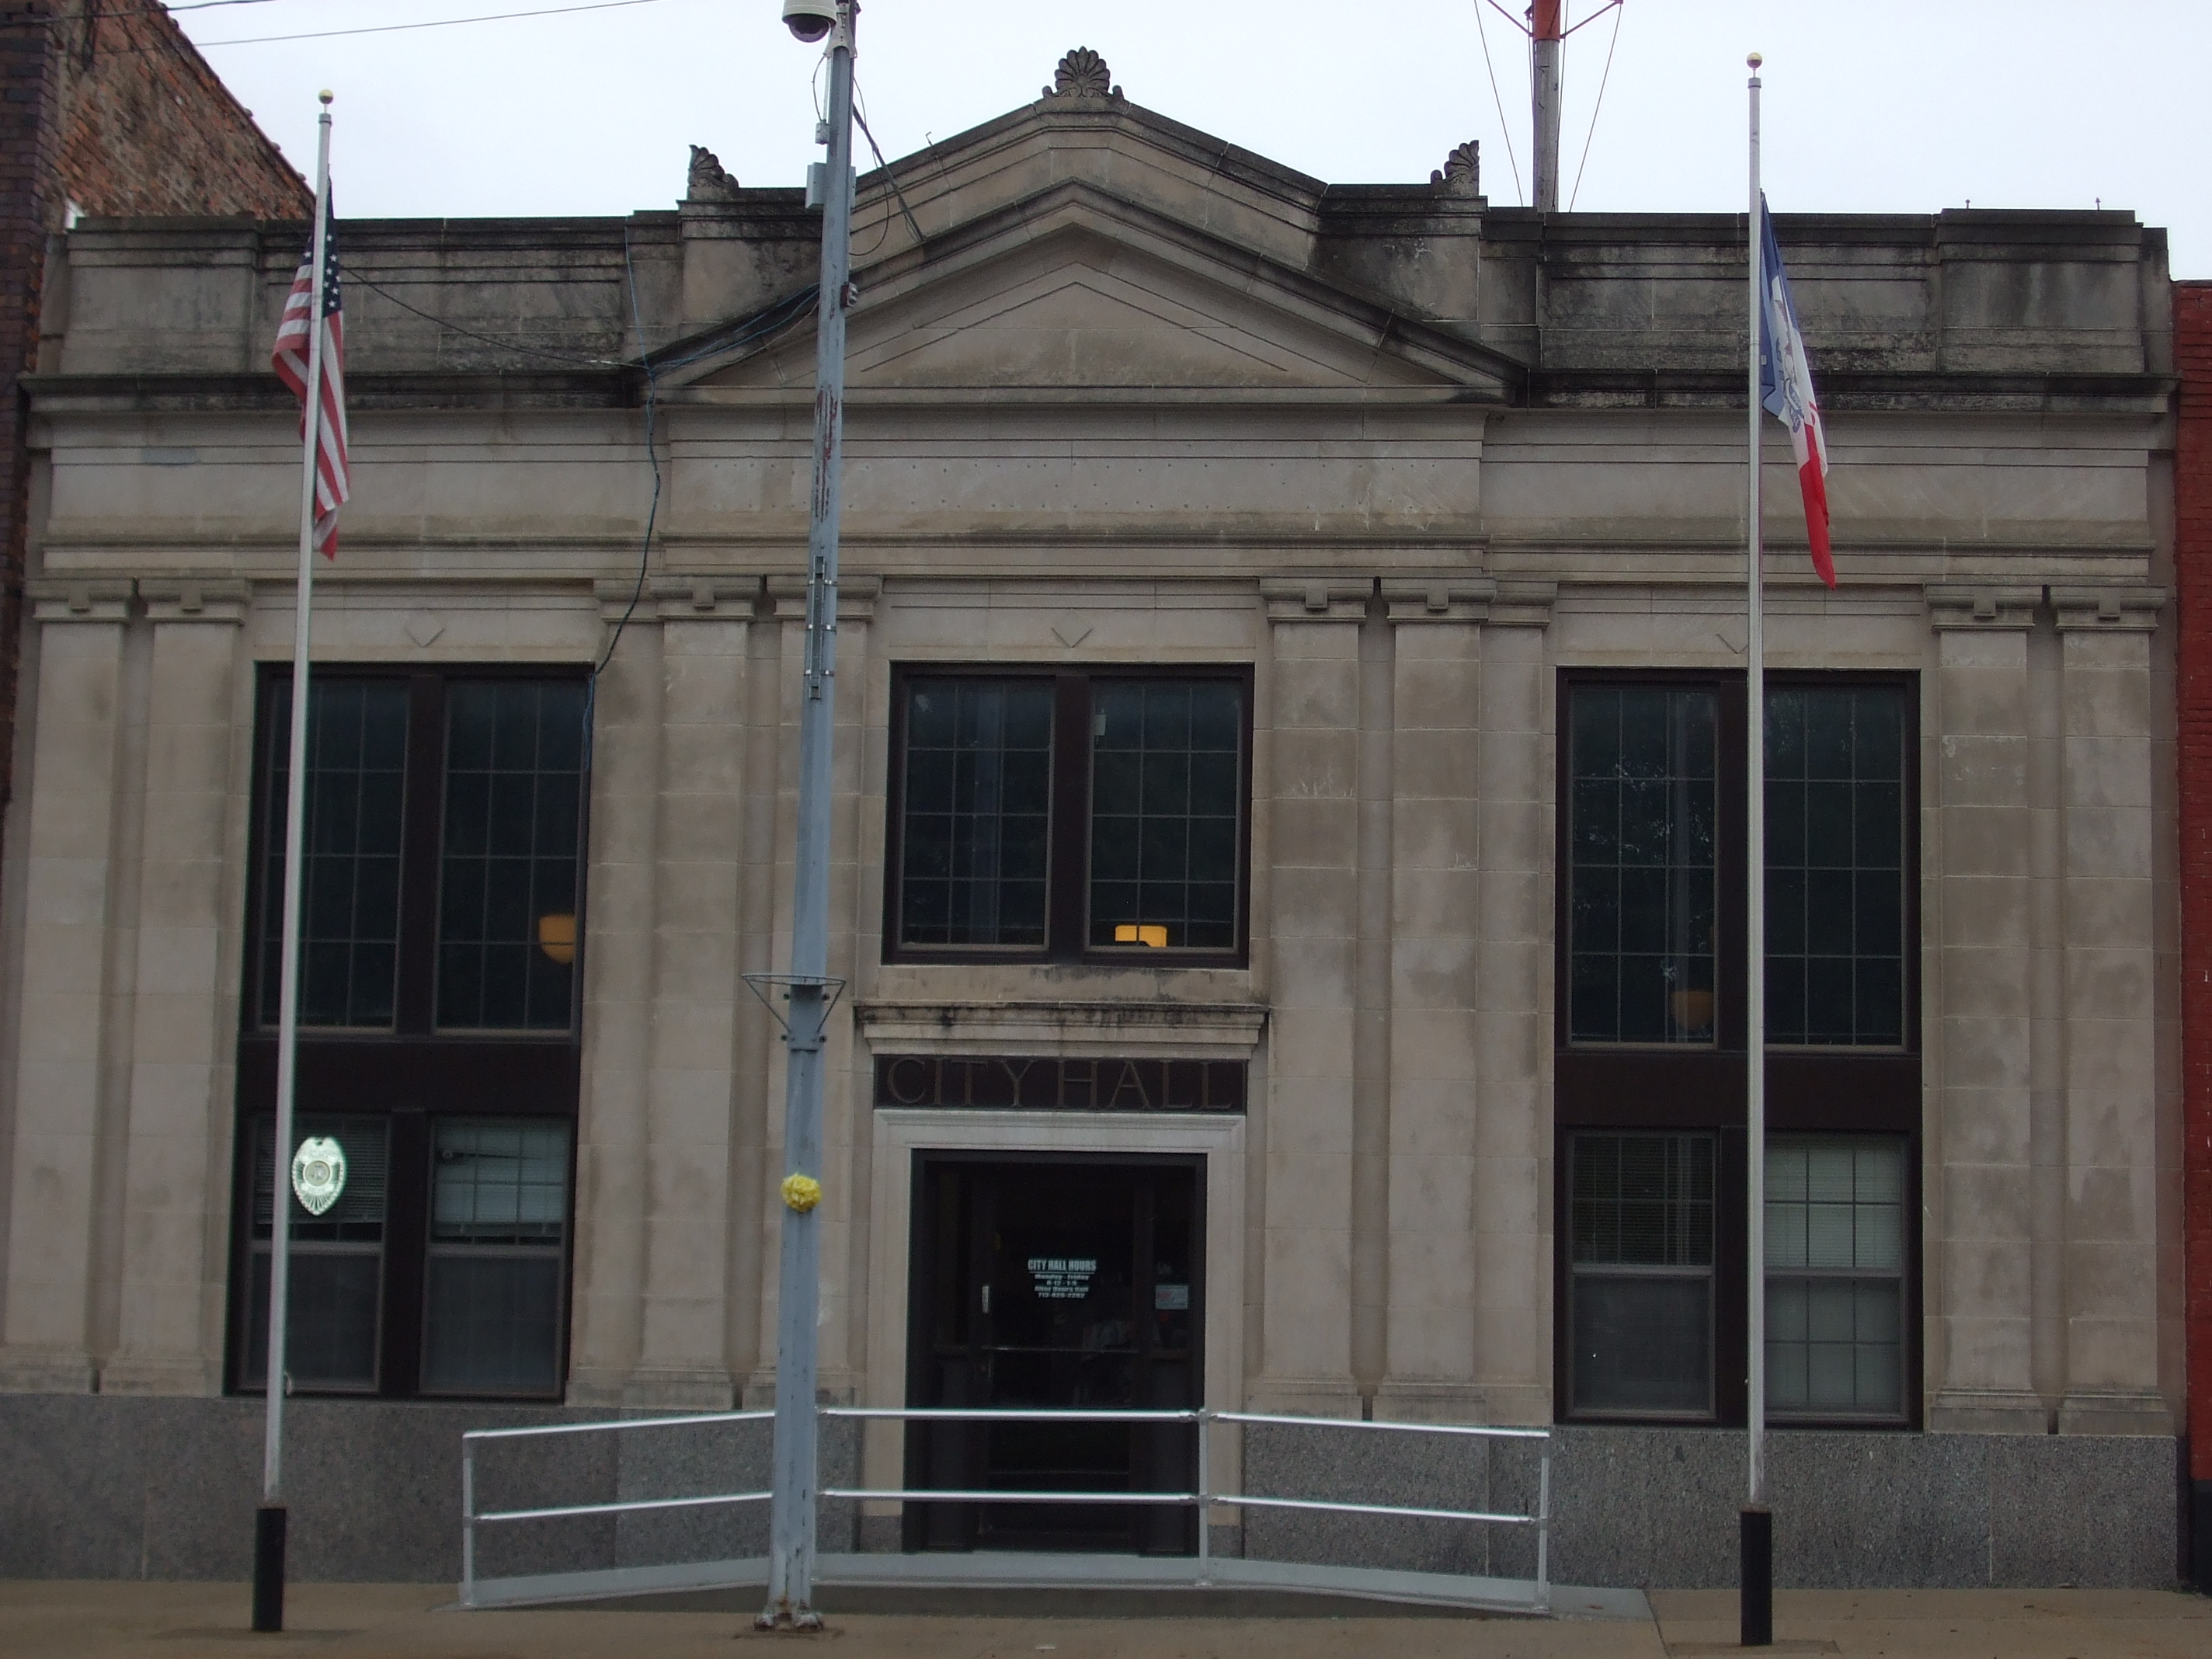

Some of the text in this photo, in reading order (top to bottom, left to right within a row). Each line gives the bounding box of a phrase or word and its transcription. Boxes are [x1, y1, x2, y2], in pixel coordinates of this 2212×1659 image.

[887, 1058, 1233, 1109] CITY HALL
[1028, 1259, 1096, 1271] CITY HALL HOURS
